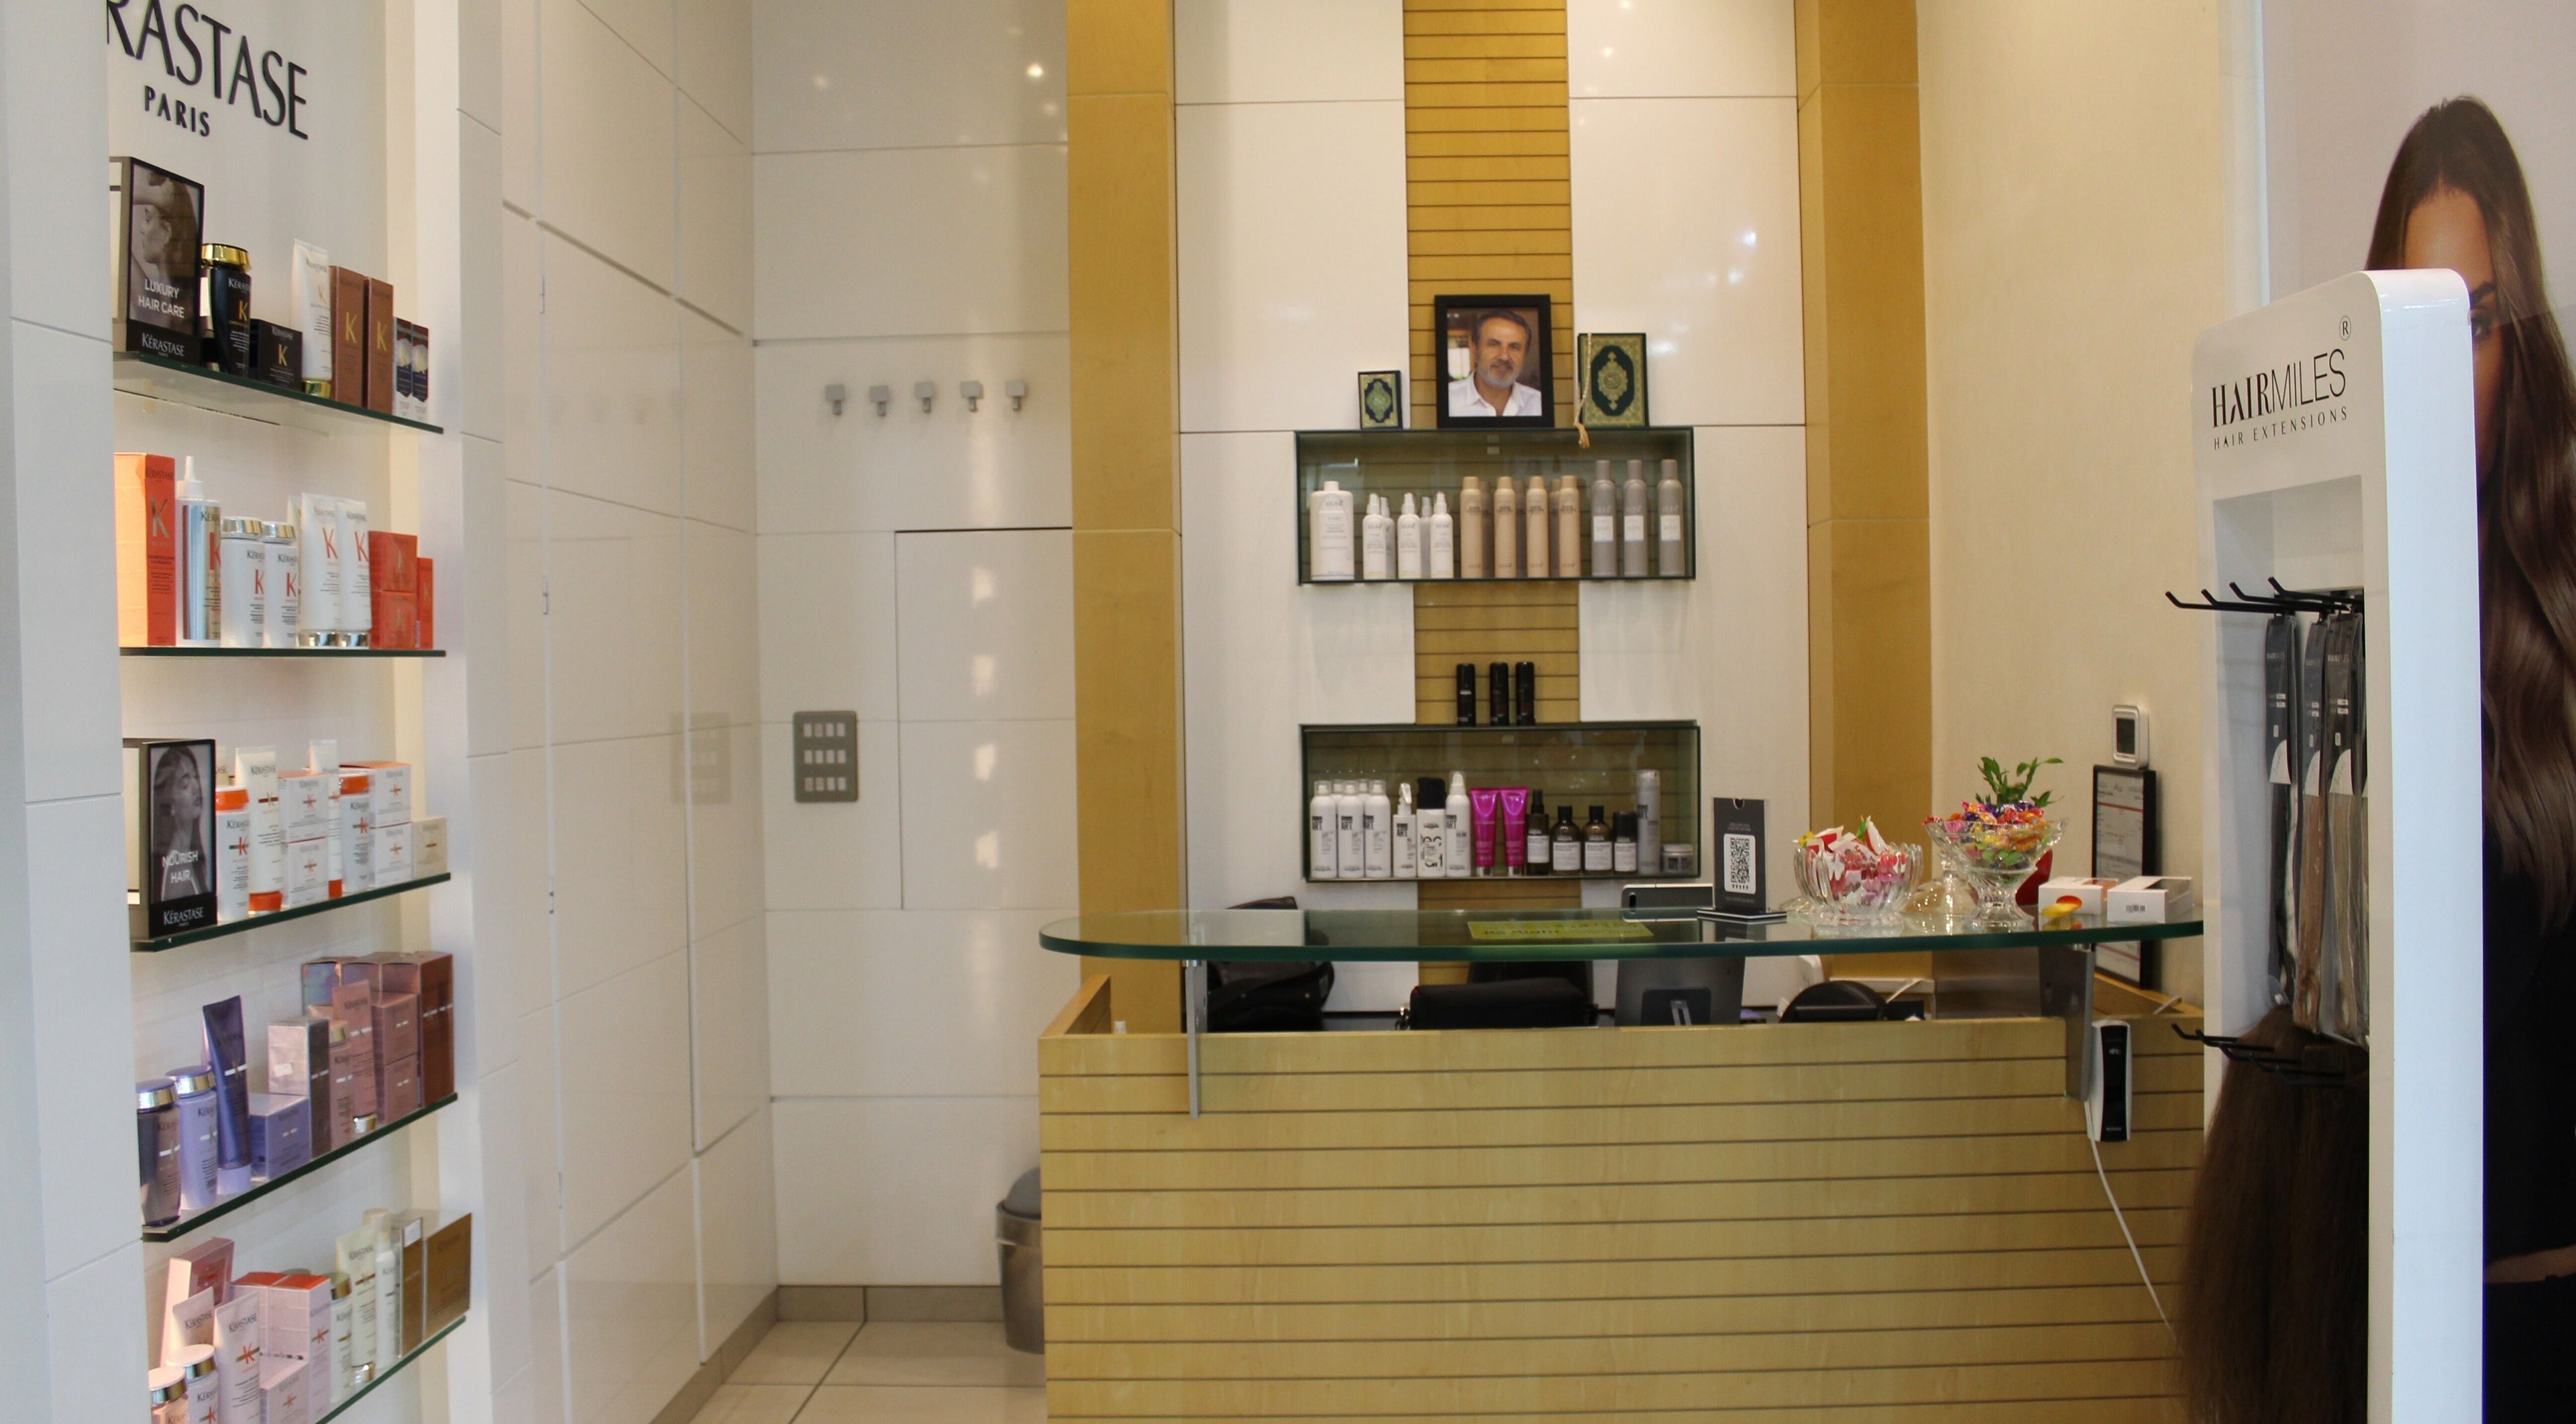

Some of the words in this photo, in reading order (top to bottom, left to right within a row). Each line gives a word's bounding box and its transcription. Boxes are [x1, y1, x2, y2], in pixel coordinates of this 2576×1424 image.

[144, 85, 211, 137] PARIS
[144, 278, 180, 299] LUXURY
[138, 294, 160, 312] HAIR
[161, 302, 185, 319] CARE
[238, 300, 248, 322] K
[345, 311, 358, 344] K
[376, 321, 388, 352] K
[142, 332, 185, 358] KÉRASTASE
[278, 343, 288, 367] K
[2212, 348, 2346, 429] HAIRMILES
[2214, 431, 2244, 450] HAIR
[2253, 406, 2347, 441] EXTENSIONS
[151, 496, 170, 539] K
[209, 532, 221, 570] K
[322, 527, 338, 560] K
[354, 531, 370, 562] K
[255, 568, 264, 595] K
[286, 571, 297, 598] K
[162, 850, 199, 867] NOURISH
[170, 869, 191, 884] HAIR
[163, 906, 204, 926] KÉRASTASE
[243, 1343, 254, 1364] K
